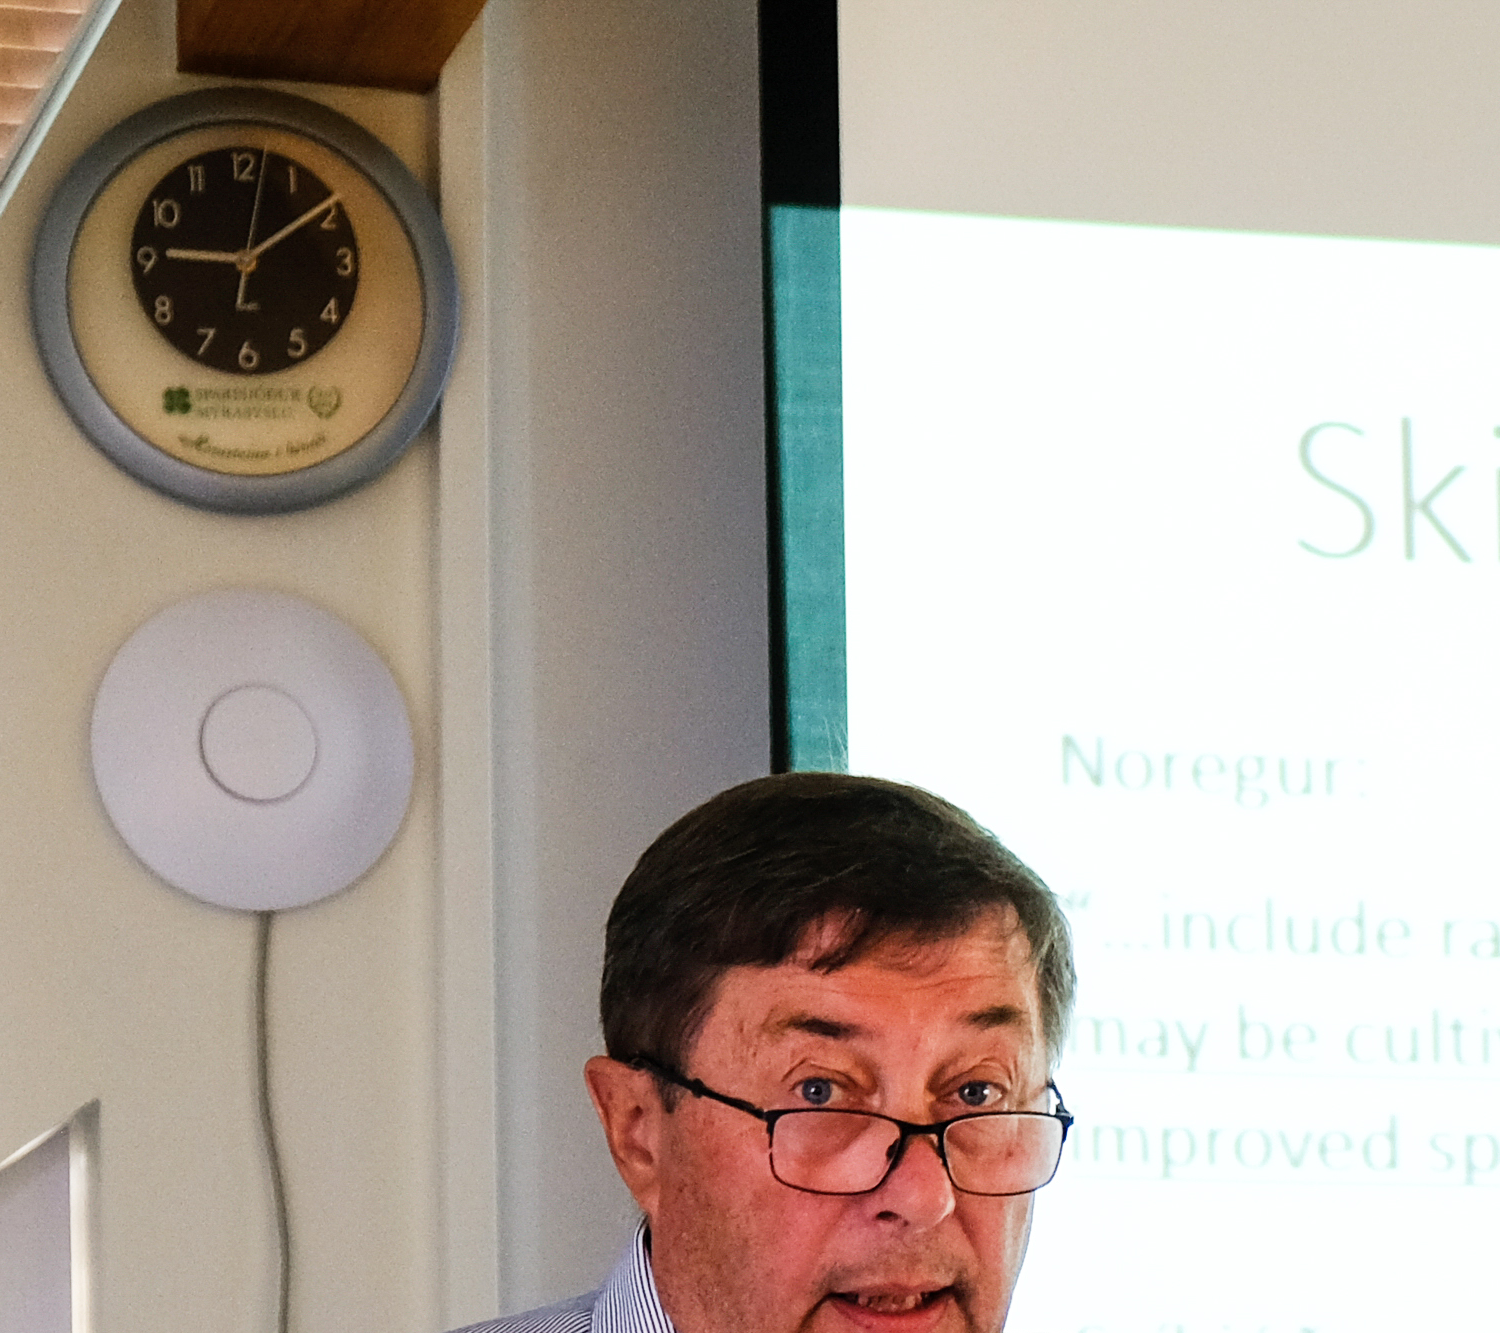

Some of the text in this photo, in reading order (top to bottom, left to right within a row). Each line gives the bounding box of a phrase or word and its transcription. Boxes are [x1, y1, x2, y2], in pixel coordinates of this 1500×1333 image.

[188, 164, 205, 192] 11
[231, 151, 256, 182] 12
[288, 165, 298, 194] 1
[152, 199, 182, 229] 10
[136, 245, 159, 275] 9
[335, 247, 355, 277] 3
[155, 294, 174, 325] 8
[319, 296, 339, 325] 4
[196, 328, 217, 356] 7
[237, 337, 261, 369] 6
[287, 329, 307, 358] 5
[1064, 1011, 1210, 1075] may
[1235, 1003, 1320, 1063] be
[1068, 1101, 1402, 1181] improved
